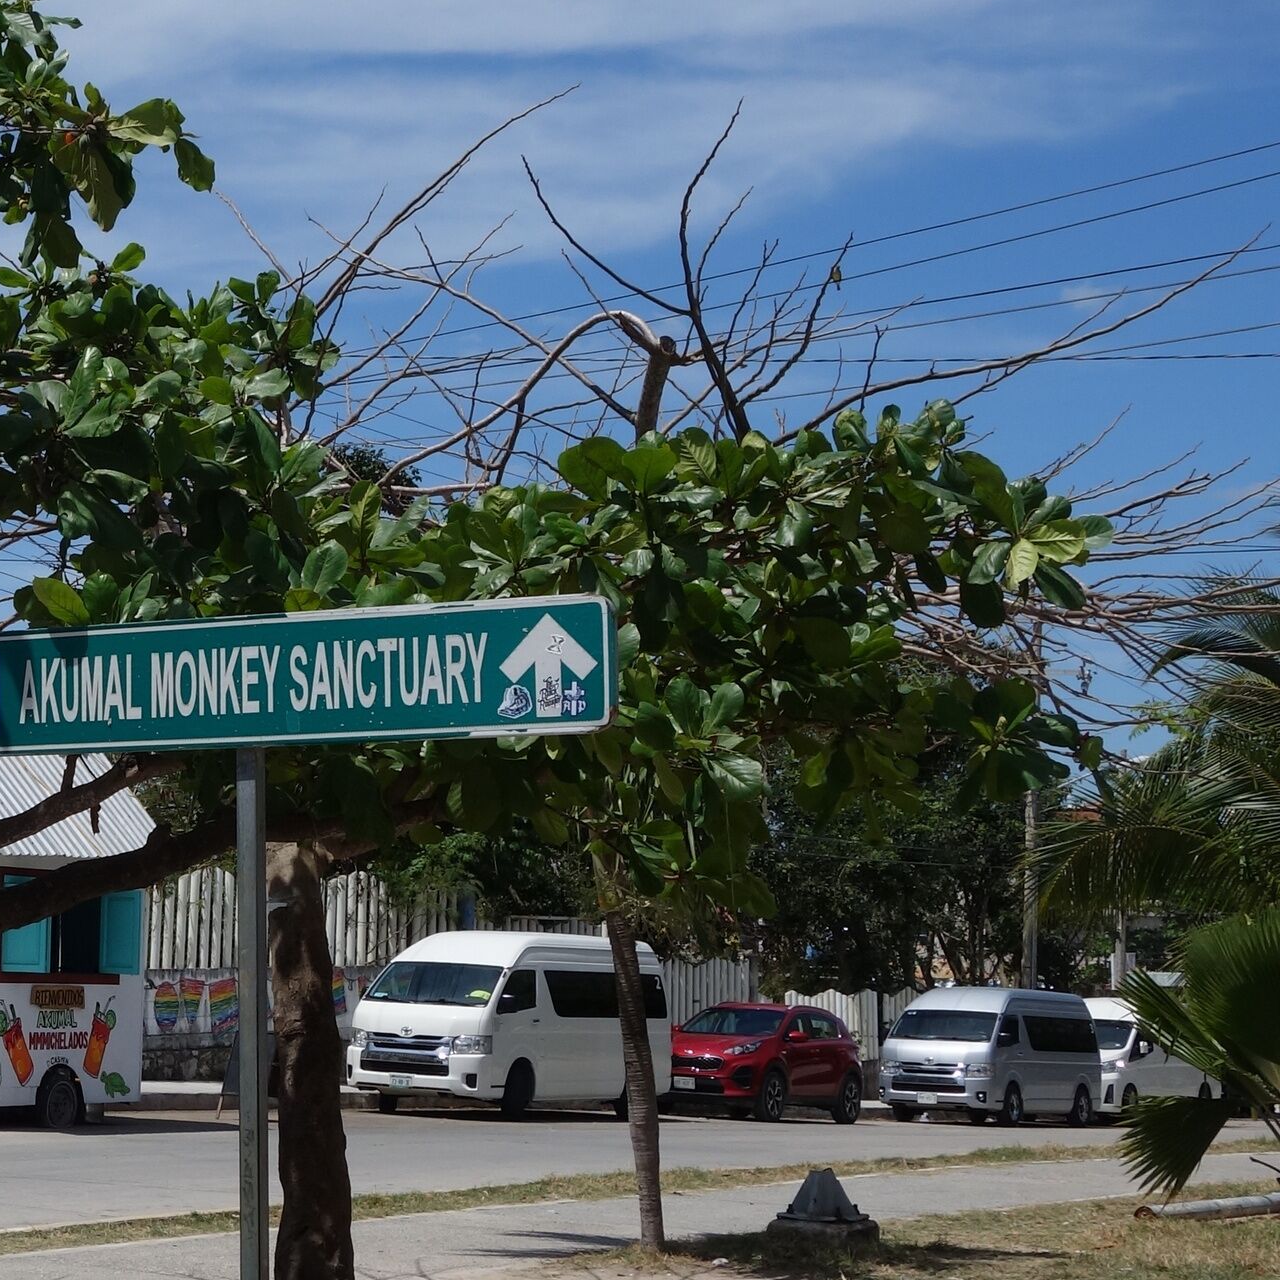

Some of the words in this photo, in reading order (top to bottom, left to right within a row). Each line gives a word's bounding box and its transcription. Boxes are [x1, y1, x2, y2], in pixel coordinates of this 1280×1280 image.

[19, 654, 142, 725] AKUMAL
[151, 645, 281, 719] MONKEY
[289, 632, 488, 712] SANCTUARY
[654, 976, 662, 990] 2
[36, 1009, 78, 1029] AKUMAL
